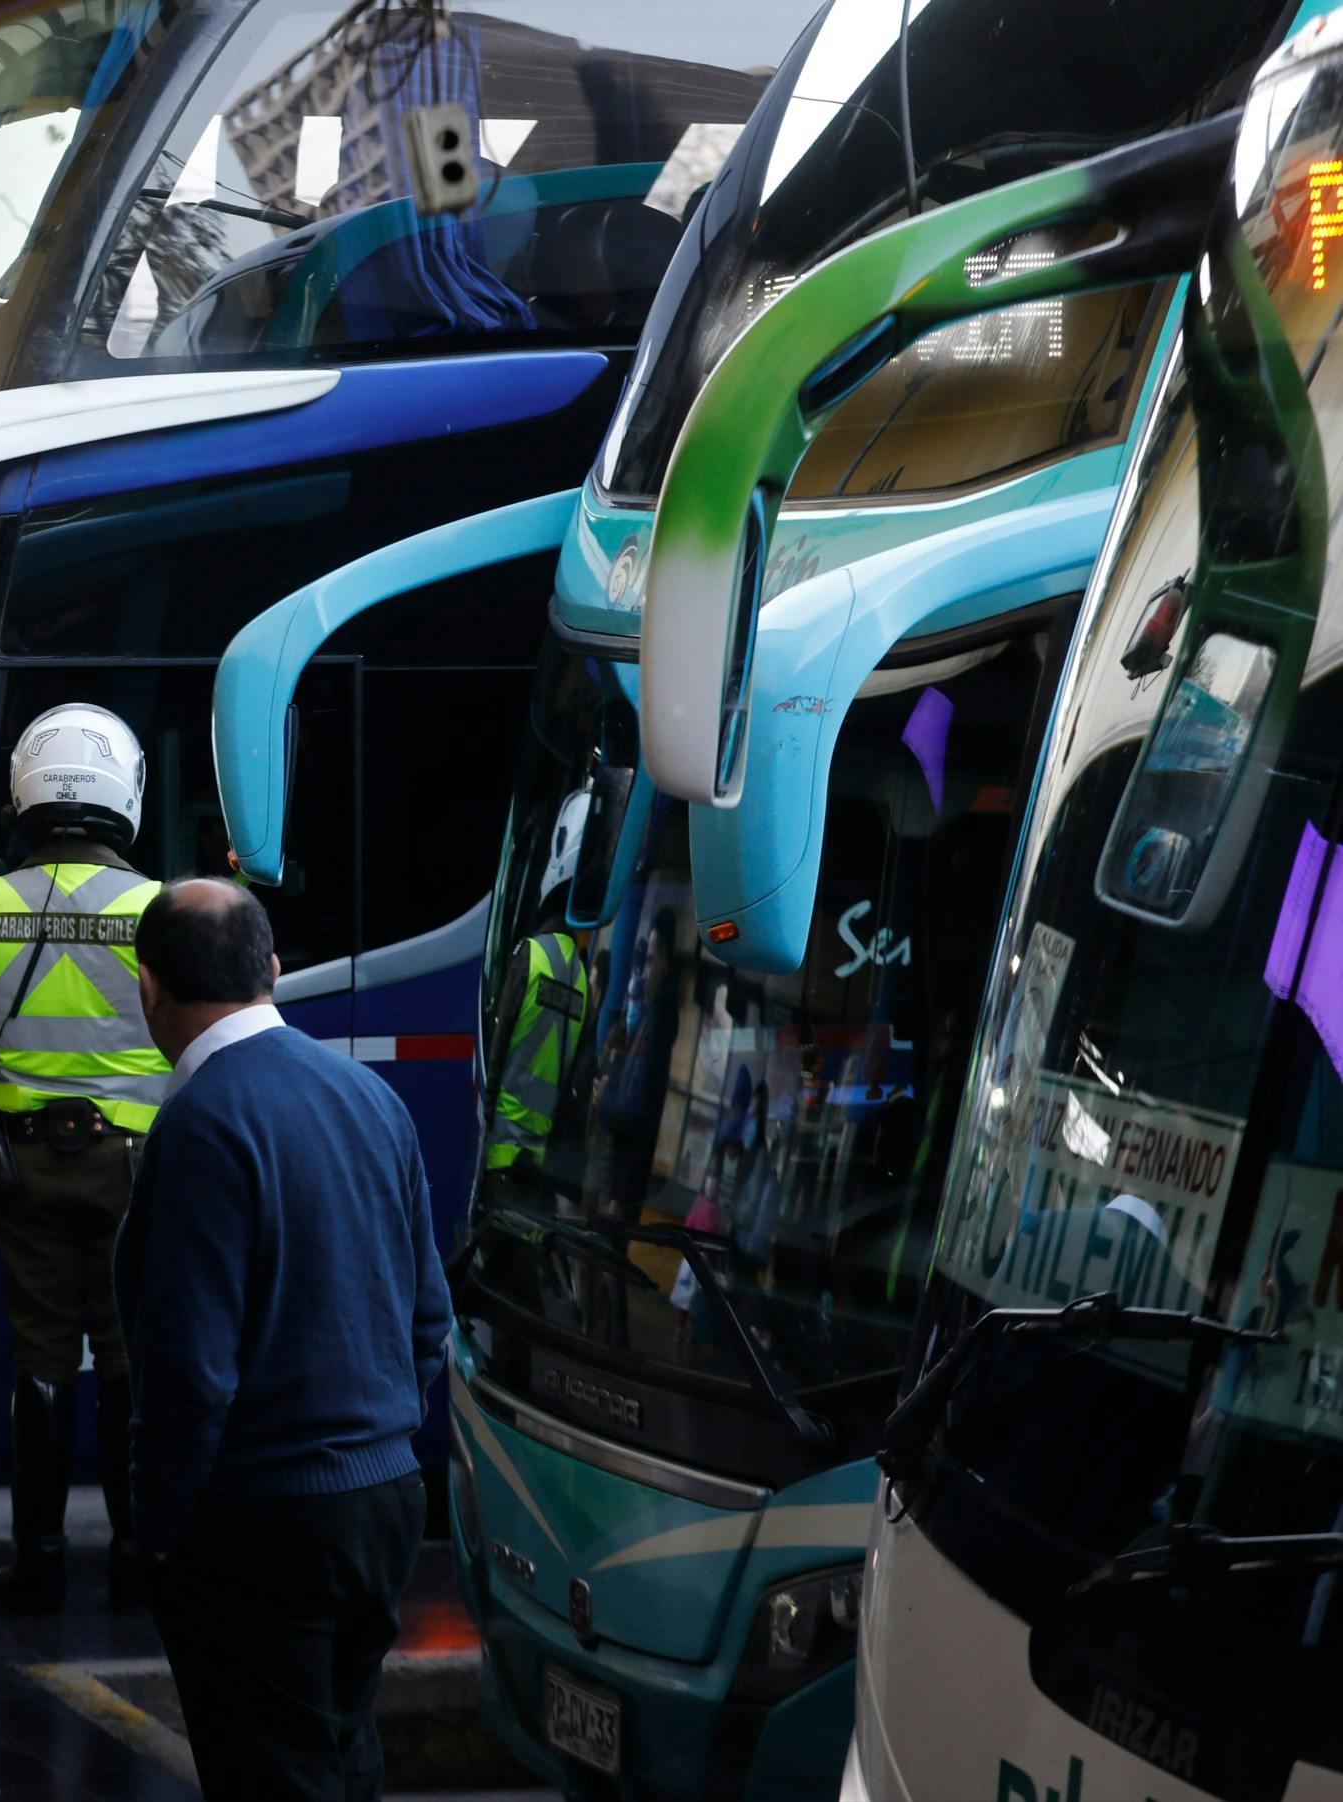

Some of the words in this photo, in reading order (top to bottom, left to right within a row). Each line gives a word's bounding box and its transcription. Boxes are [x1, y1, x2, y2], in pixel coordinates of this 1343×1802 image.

[43, 773, 97, 784] CARABINEROS
[56, 791, 78, 801] CHILE
[62, 783, 73, 792] DE
[79, 918, 95, 940] DE
[98, 918, 134, 942] CHILE
[1113, 1118, 1227, 1199] FERNANDO
[1088, 1683, 1201, 1779] IRIZAR
